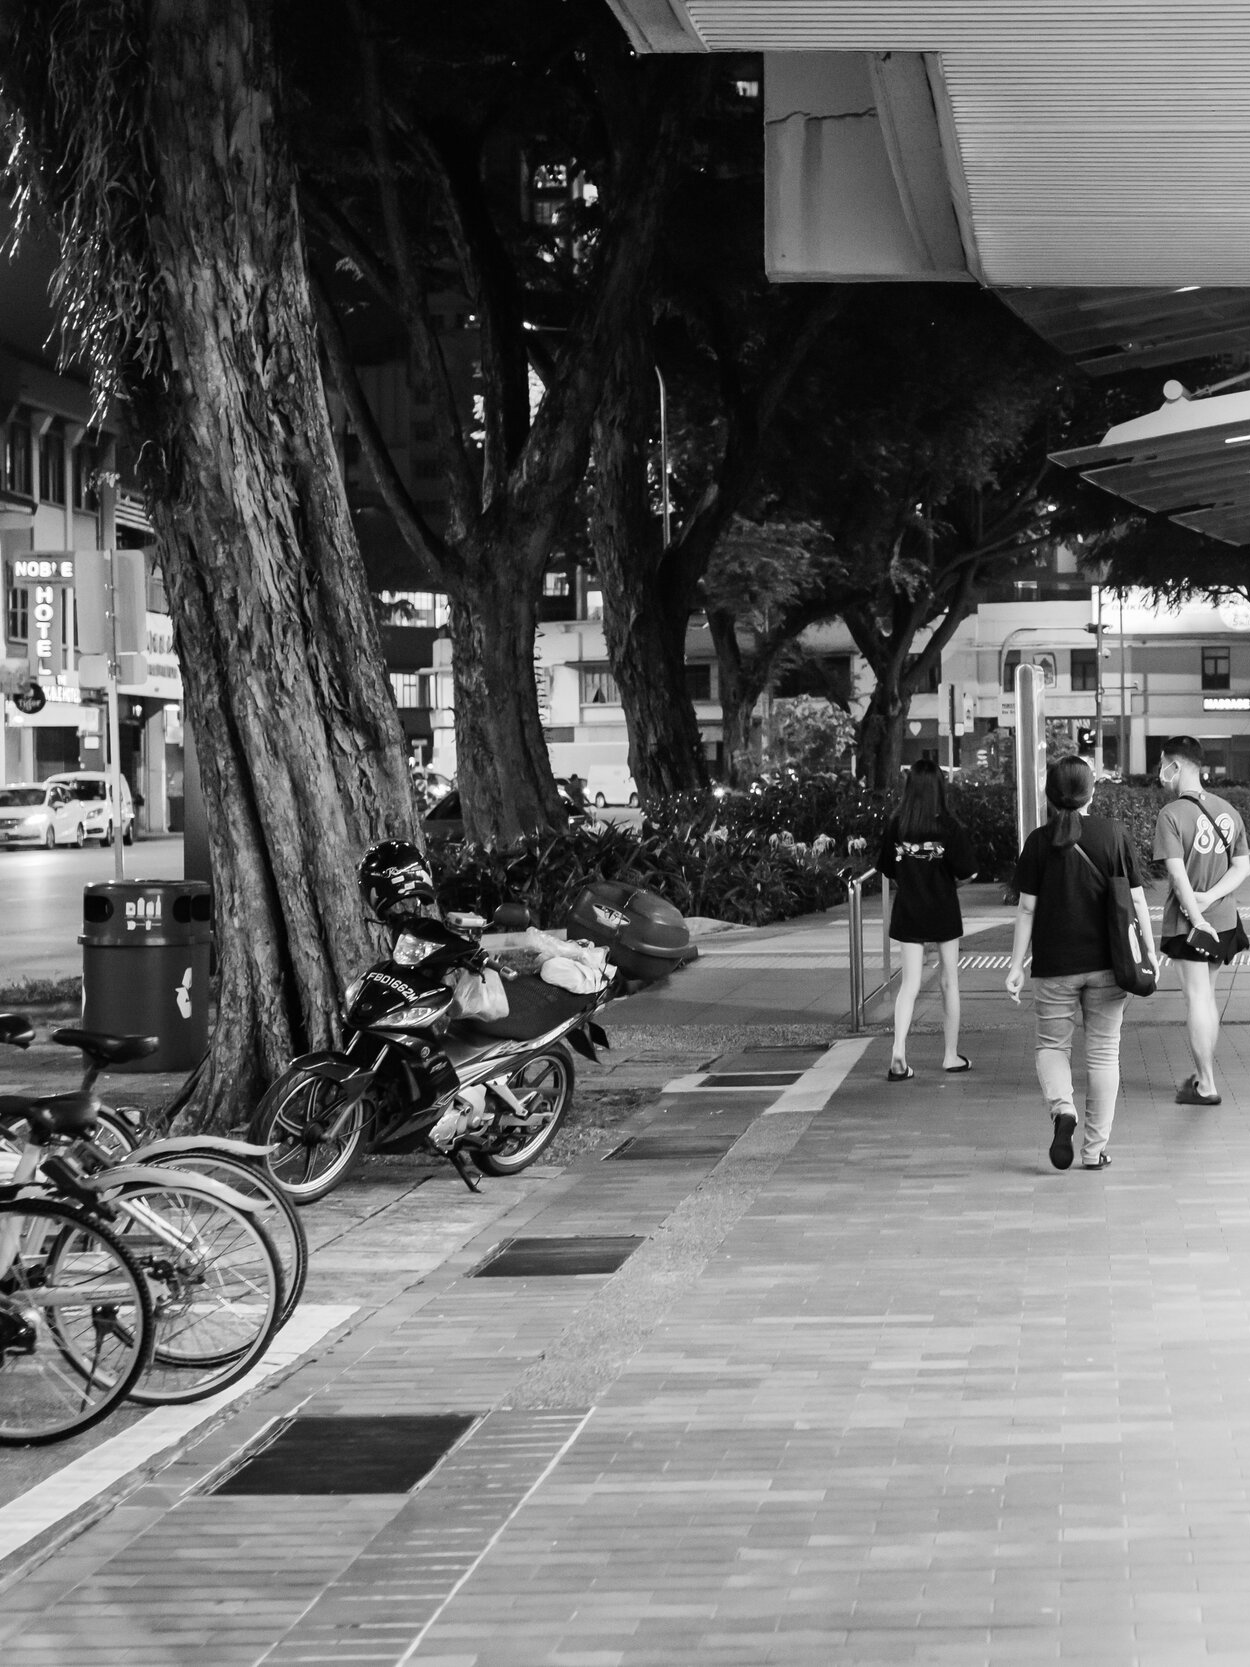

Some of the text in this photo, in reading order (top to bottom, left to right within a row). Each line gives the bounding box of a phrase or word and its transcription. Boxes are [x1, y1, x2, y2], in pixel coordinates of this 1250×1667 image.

[34, 586, 54, 676] HOTEL
[1204, 698, 1250, 710] MASSAGE
[1193, 812, 1235, 855] 89
[366, 972, 419, 1003] FBD1662M
